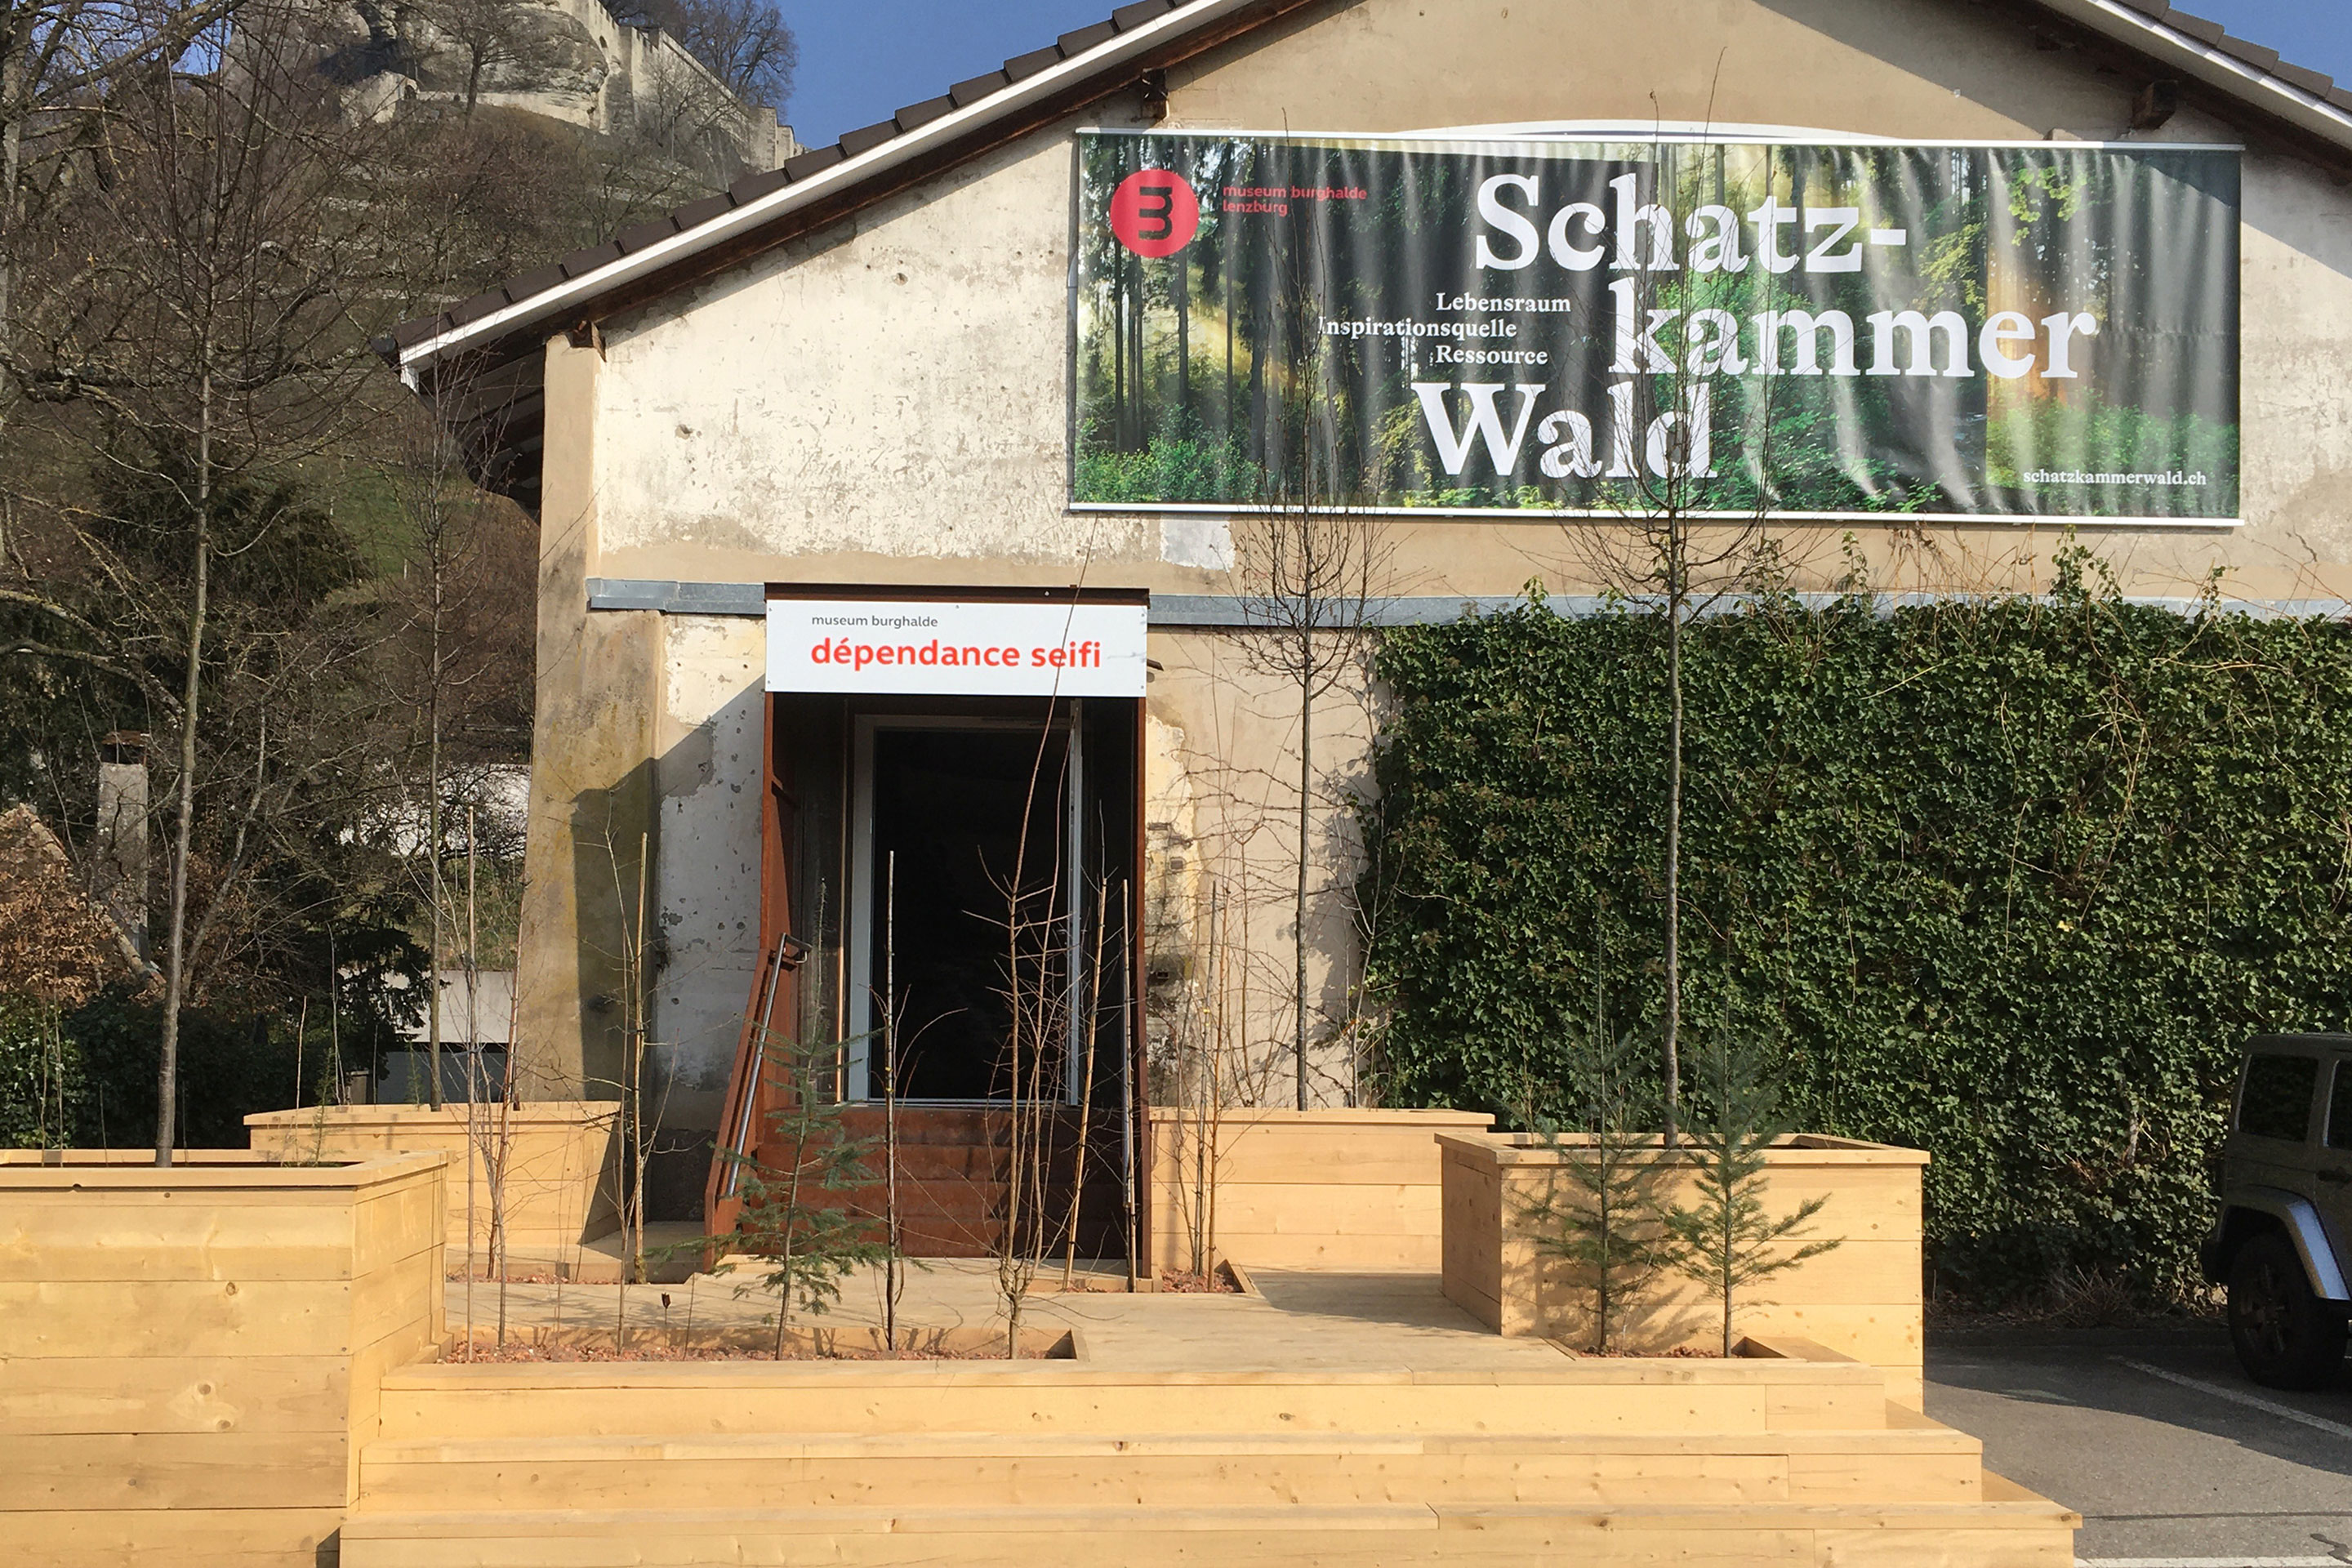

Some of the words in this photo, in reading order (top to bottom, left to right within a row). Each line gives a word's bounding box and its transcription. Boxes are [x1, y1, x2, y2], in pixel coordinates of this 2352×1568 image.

[1223, 186, 1287, 198] museum
[1290, 185, 1368, 202] burghalde
[1223, 201, 1288, 217] lenzburg
[1476, 172, 1907, 274] Schatz-
[1436, 292, 1571, 313] Lebensraum
[1317, 316, 1517, 341] Inspirationsquelle
[1608, 277, 2099, 380] kammer
[1436, 345, 1548, 365] Ressource
[1410, 381, 1718, 480] Wald
[2023, 469, 2207, 486] schatzkammerwald.ch
[811, 616, 868, 627] museum
[871, 615, 938, 629] burghalde
[811, 637, 1019, 671] dépendance
[1031, 641, 1101, 668] seifi
